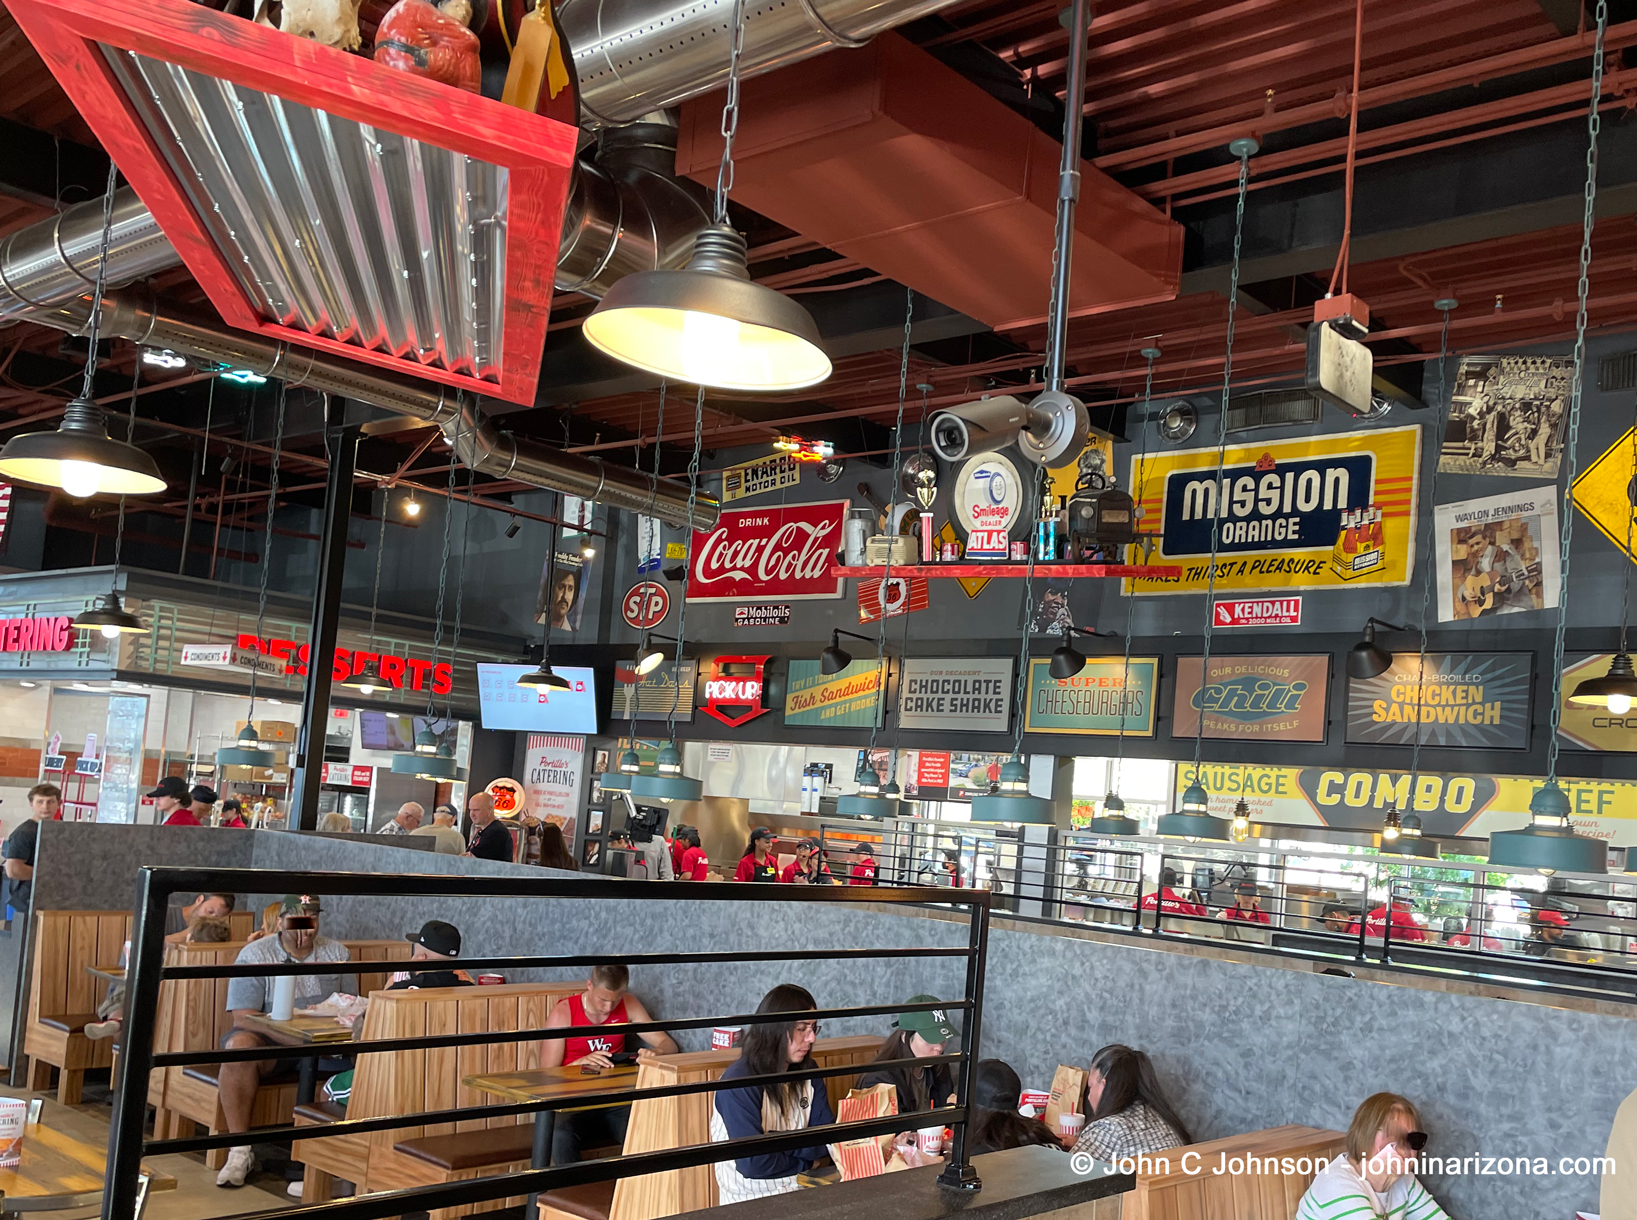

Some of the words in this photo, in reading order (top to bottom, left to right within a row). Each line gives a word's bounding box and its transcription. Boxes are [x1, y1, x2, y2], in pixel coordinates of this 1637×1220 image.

[745, 476, 776, 494] MOTOR
[780, 474, 796, 486] OIL
[1182, 467, 1350, 520] MISSION
[972, 504, 1010, 520] Smileage
[1455, 510, 1490, 522] WAYLON
[1492, 502, 1535, 516] JENNINGS
[738, 517, 770, 528] DRINK
[1222, 517, 1300, 544] ORANGE
[968, 530, 1007, 550] ATLAS
[695, 518, 840, 584] Coca-Cola
[1186, 562, 1238, 582] THIRST
[1236, 561, 1244, 576] A
[1250, 558, 1326, 577] PLEASURE
[626, 587, 664, 622] STP
[748, 605, 790, 618] Mobiloils
[1234, 600, 1298, 618] KENDALL
[737, 616, 780, 626] GASOLINE
[190, 652, 220, 662] CONDIMENTS
[240, 656, 276, 672] CONDMENTS
[659, 672, 692, 688] Dos
[1210, 668, 1232, 677] OUR
[1234, 666, 1290, 678] DELICIOUS
[1395, 674, 1482, 683] CHAR-BROILED
[705, 680, 736, 699] PICK
[792, 680, 804, 692] TRY
[806, 678, 813, 686] IT
[814, 674, 836, 685] TODAY
[908, 679, 1002, 695] CHOCOLATE
[1057, 677, 1124, 688] SUPER
[790, 692, 818, 712] Fish
[820, 674, 882, 704] Sandwich
[1190, 680, 1308, 712] Chili
[1390, 684, 1484, 706] CHICKEN
[820, 707, 836, 720] AND
[836, 703, 850, 716] GET
[850, 696, 878, 712] HOOKE
[904, 697, 946, 712] CAKE
[949, 698, 1004, 714] SHAKE
[1038, 689, 1144, 716] CHEESEBURGERS
[1372, 700, 1502, 724] SANDWICH
[1238, 724, 1260, 732] FOR
[1263, 720, 1300, 732] ITSELF
[540, 756, 569, 769] Portillo's
[531, 768, 574, 787] CATERING
[1184, 770, 1288, 795] SAUSAGE
[1316, 772, 1476, 814] COMBO
[1532, 786, 1614, 814] EF
[494, 797, 510, 808] 66
[1572, 819, 1600, 828] own
[932, 1010, 946, 1022] NY
[713, 1038, 729, 1047] CAKE
[714, 1032, 729, 1040] FREE
